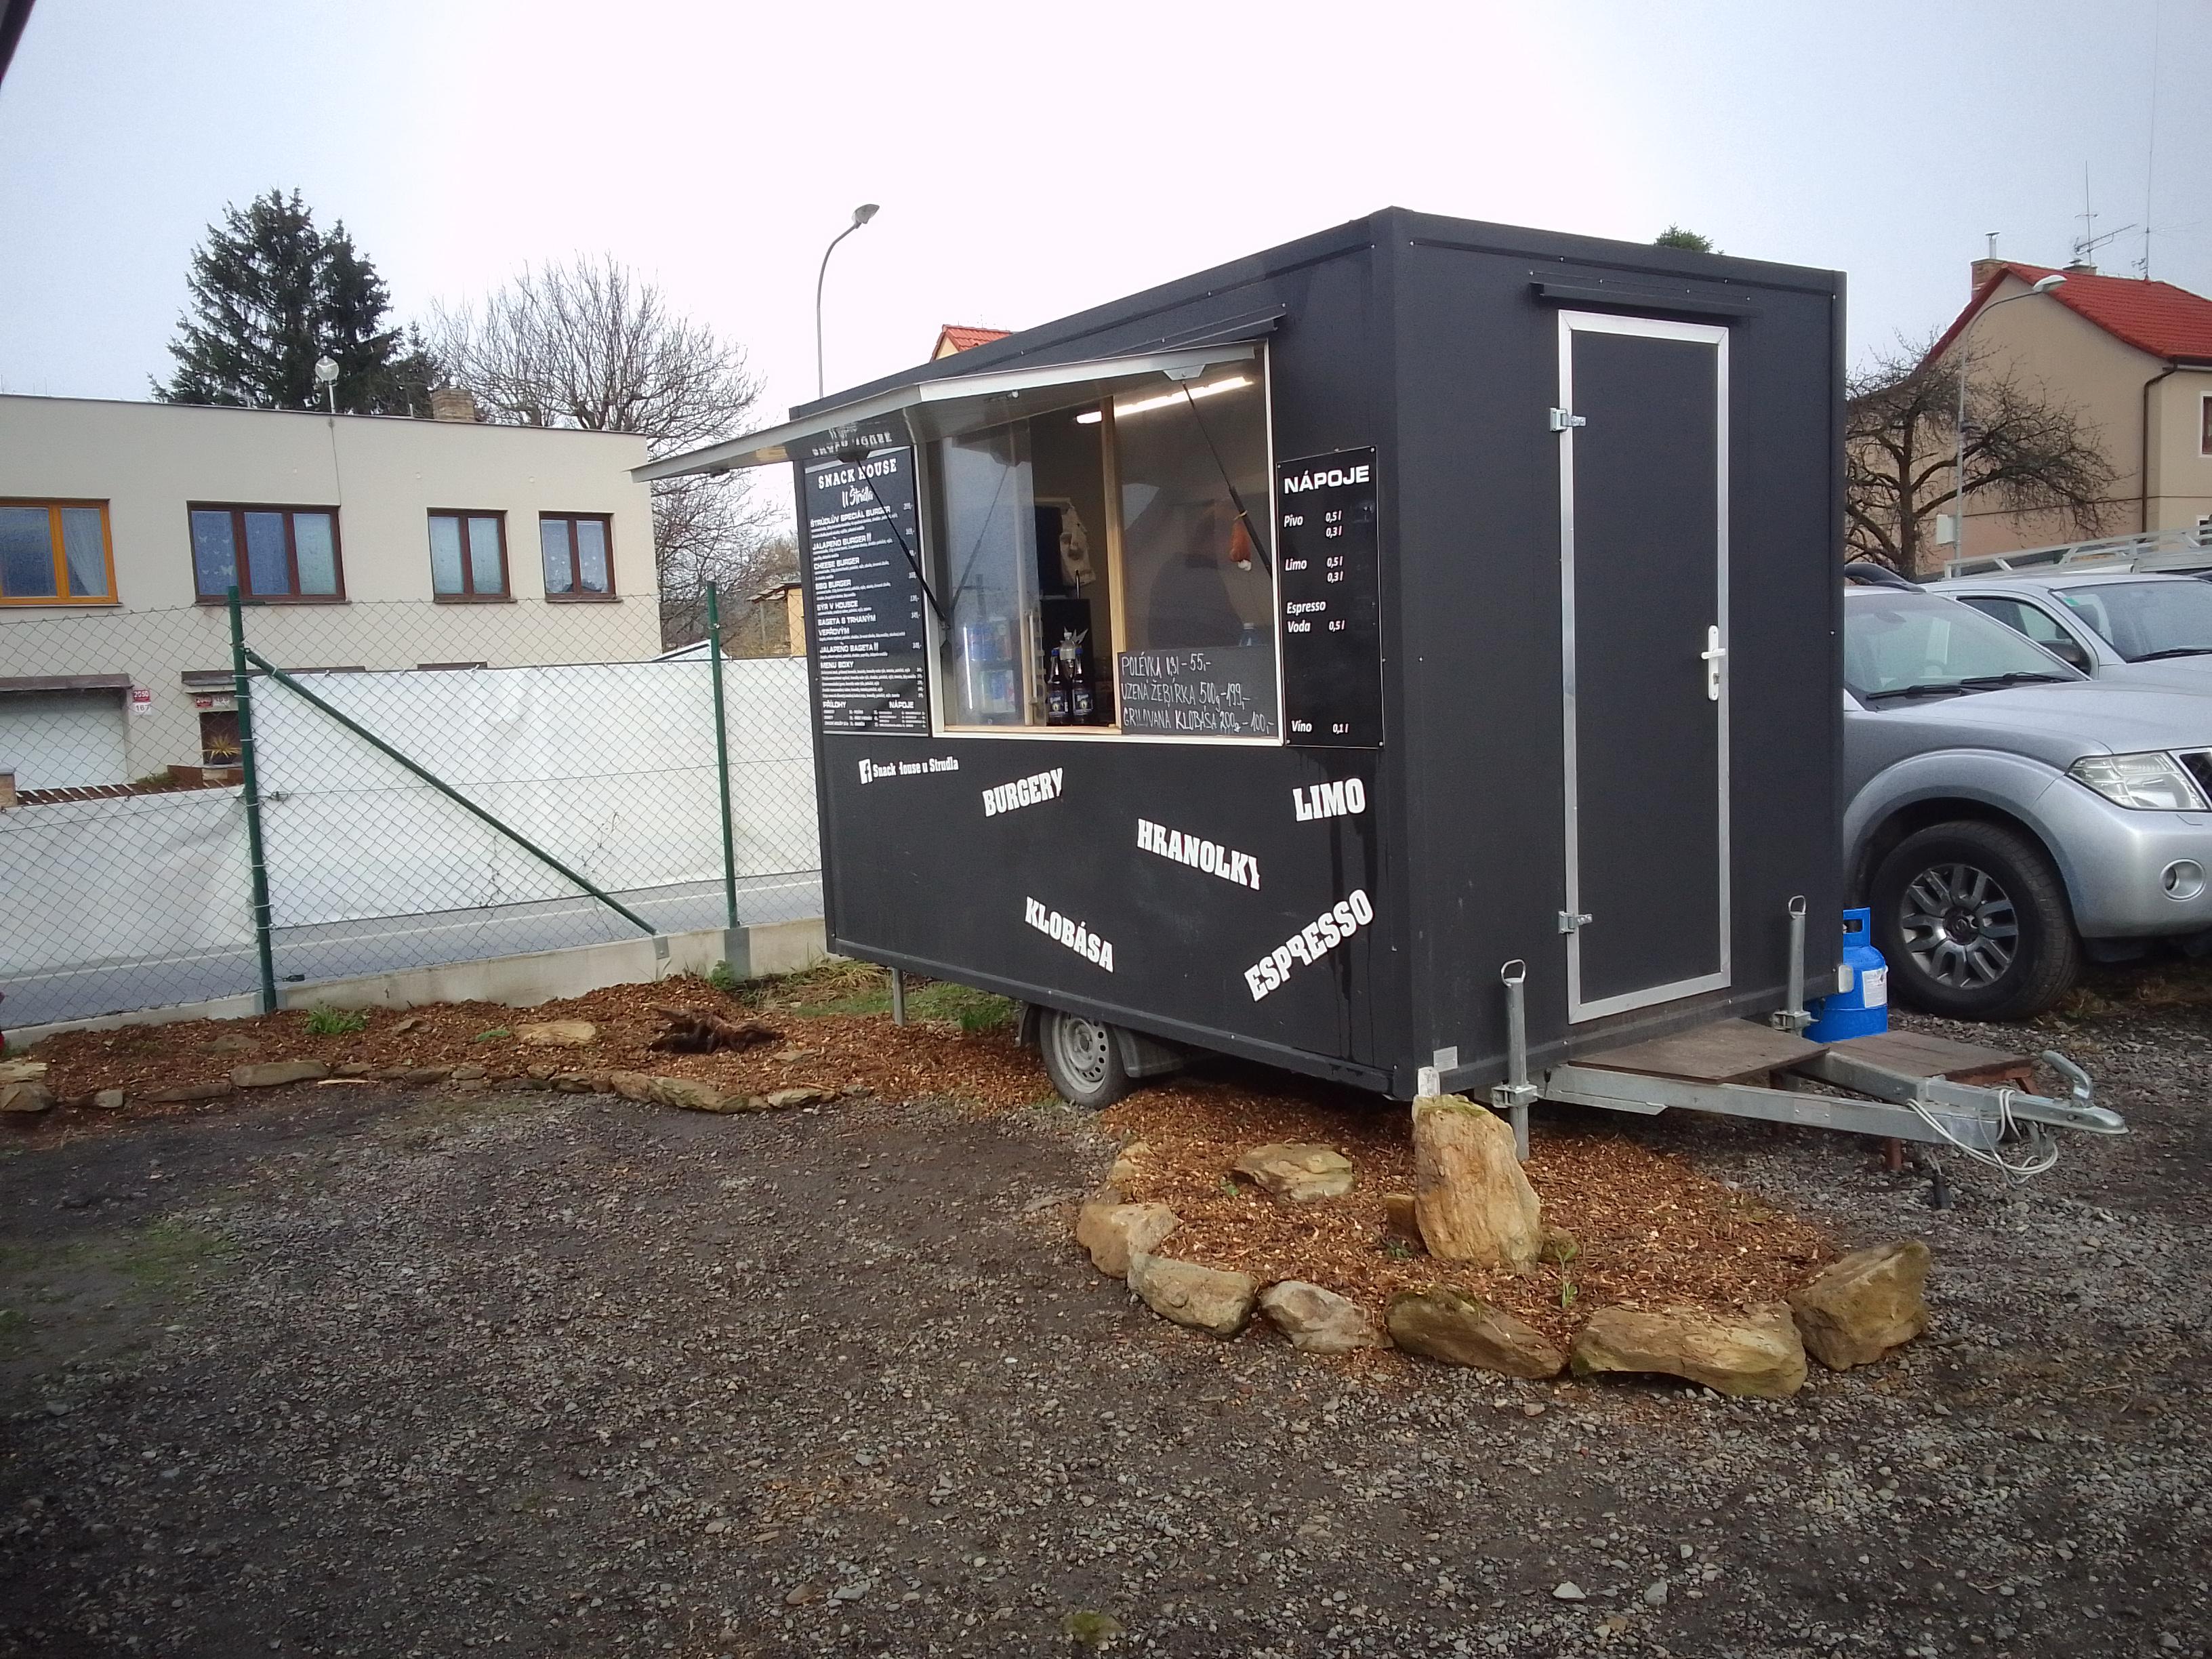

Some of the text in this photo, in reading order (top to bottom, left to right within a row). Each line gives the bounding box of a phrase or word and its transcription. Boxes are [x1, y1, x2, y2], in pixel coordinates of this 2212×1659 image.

[818, 458, 897, 489] SNACK HOUSE
[1284, 465, 1370, 494] NÁPOJE
[865, 506, 890, 516] BURGER
[1284, 514, 1303, 528] Pivo
[814, 560, 836, 570] CHEESE
[836, 557, 860, 567] BURGER
[1285, 558, 1307, 571] Limo
[828, 579, 851, 588] BURGER
[1286, 600, 1326, 616] Espresso
[1287, 619, 1311, 633] Voda
[1122, 651, 1162, 678] POLÉVKA
[1151, 678, 1195, 705] ŽEBÍRKA
[888, 699, 914, 709] NÁPOJE
[1175, 705, 1216, 731] KLOBÁSA
[1291, 720, 1313, 733] Víno
[872, 762, 897, 777] Snack
[922, 762, 928, 773] u
[982, 767, 1063, 817] BURGERY
[1292, 777, 1366, 821] LIMO
[1137, 817, 1261, 890] HRANOLKY
[1025, 896, 1113, 973] KLOBÁSA
[1244, 889, 1374, 1002] ESPRESSO
